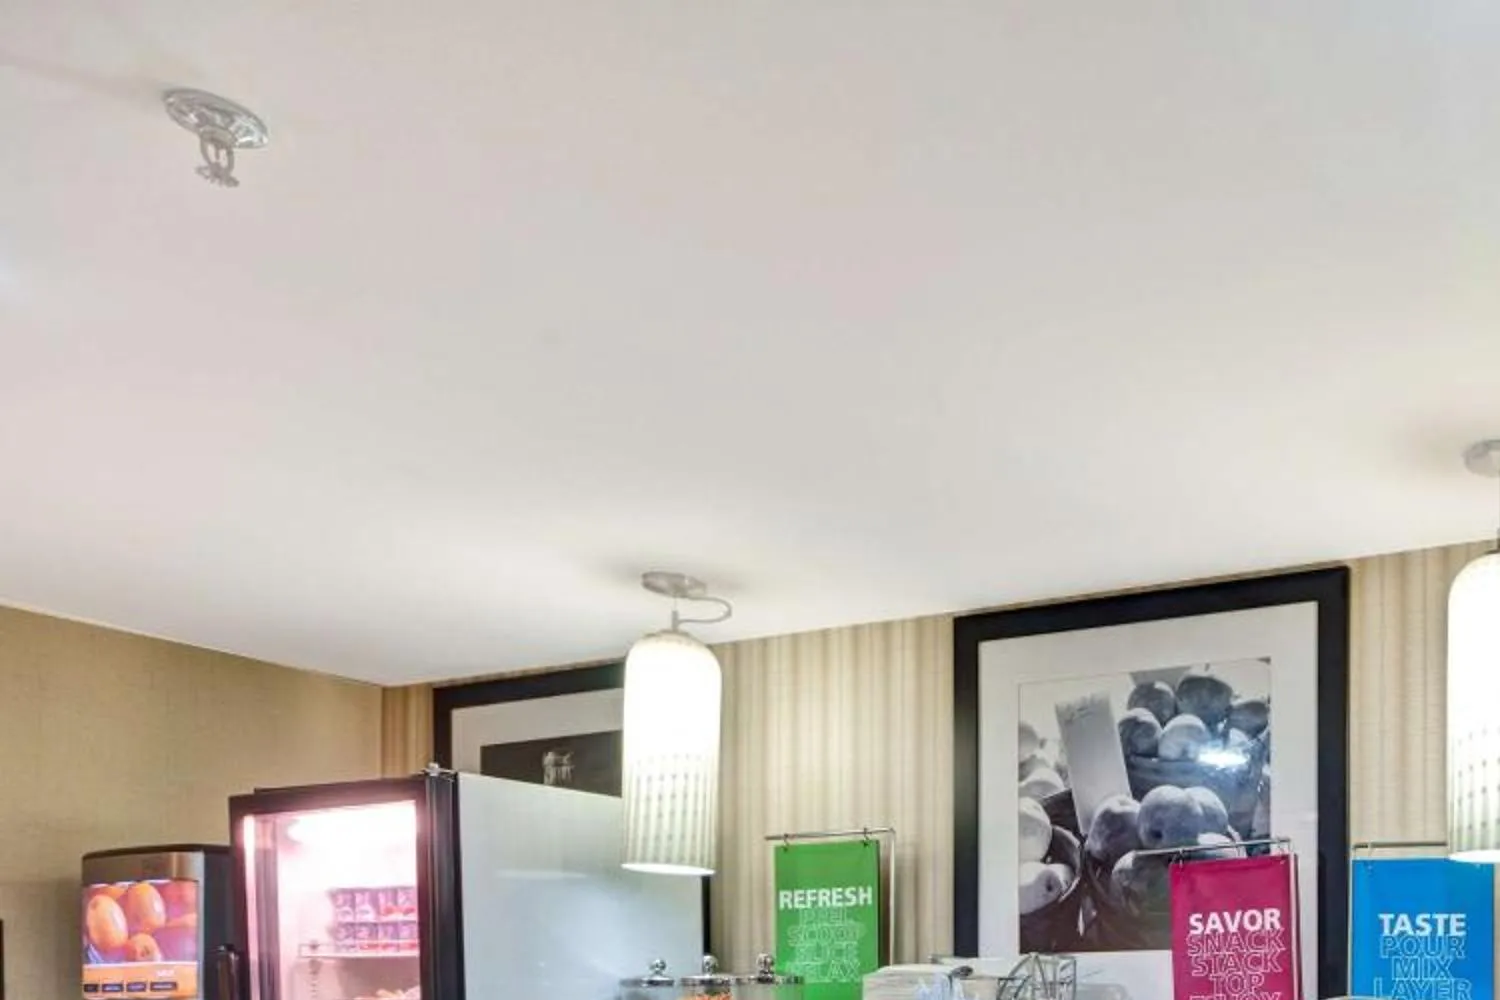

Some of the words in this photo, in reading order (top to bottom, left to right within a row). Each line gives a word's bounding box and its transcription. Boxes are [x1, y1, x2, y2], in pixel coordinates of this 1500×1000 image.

[779, 886, 873, 910] REFRESH
[1189, 908, 1281, 934] SAVOR
[1378, 913, 1467, 937] TASTE
[787, 920, 868, 947] SCOOP
[1186, 928, 1286, 957] SNACK
[1380, 935, 1466, 959] POUR
[785, 959, 861, 983] RELAX
[1191, 950, 1283, 977] STACK
[1392, 956, 1454, 980] MIX
[1209, 971, 1265, 995] TOP
